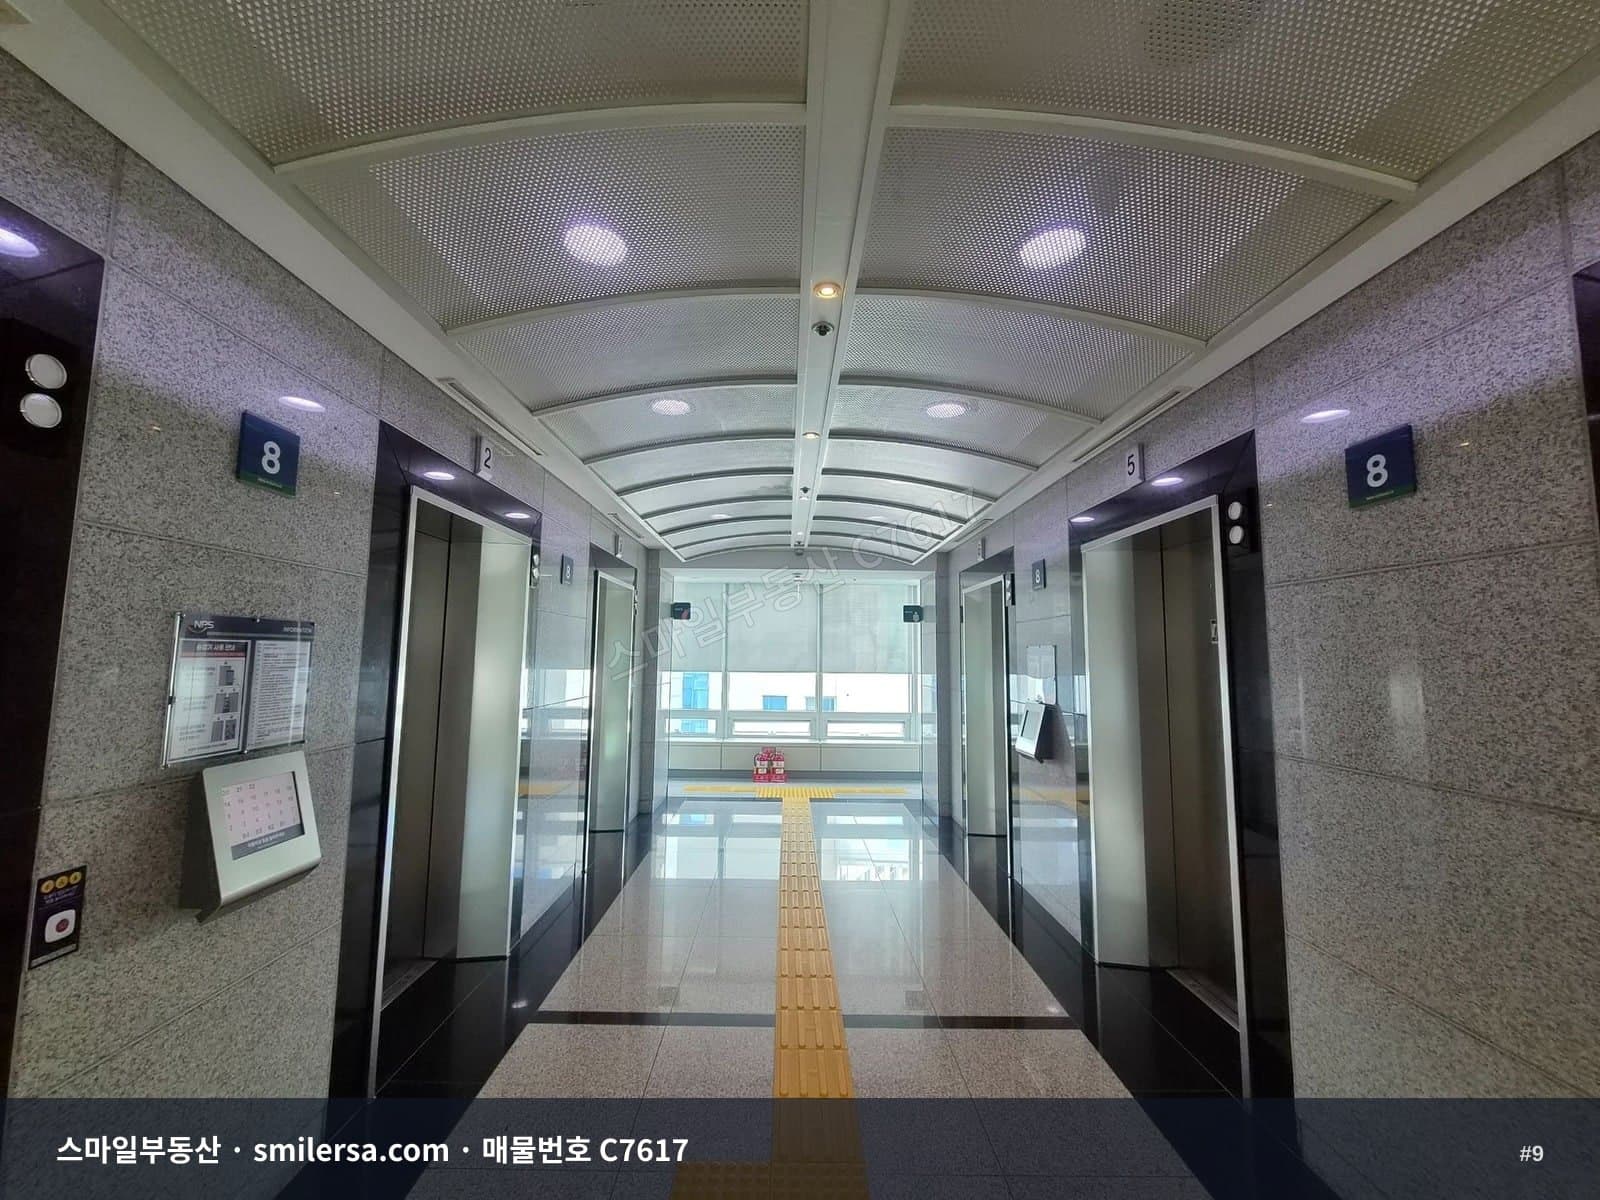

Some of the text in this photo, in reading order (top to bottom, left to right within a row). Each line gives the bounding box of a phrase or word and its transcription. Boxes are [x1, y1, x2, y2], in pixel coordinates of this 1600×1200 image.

[262, 441, 280, 474] 8
[484, 447, 491, 469] 2
[1127, 453, 1136, 476] 5
[1366, 454, 1388, 488] 8
[566, 565, 570, 579] 8
[1035, 569, 1040, 583] 8
[193, 620, 214, 629] NPS
